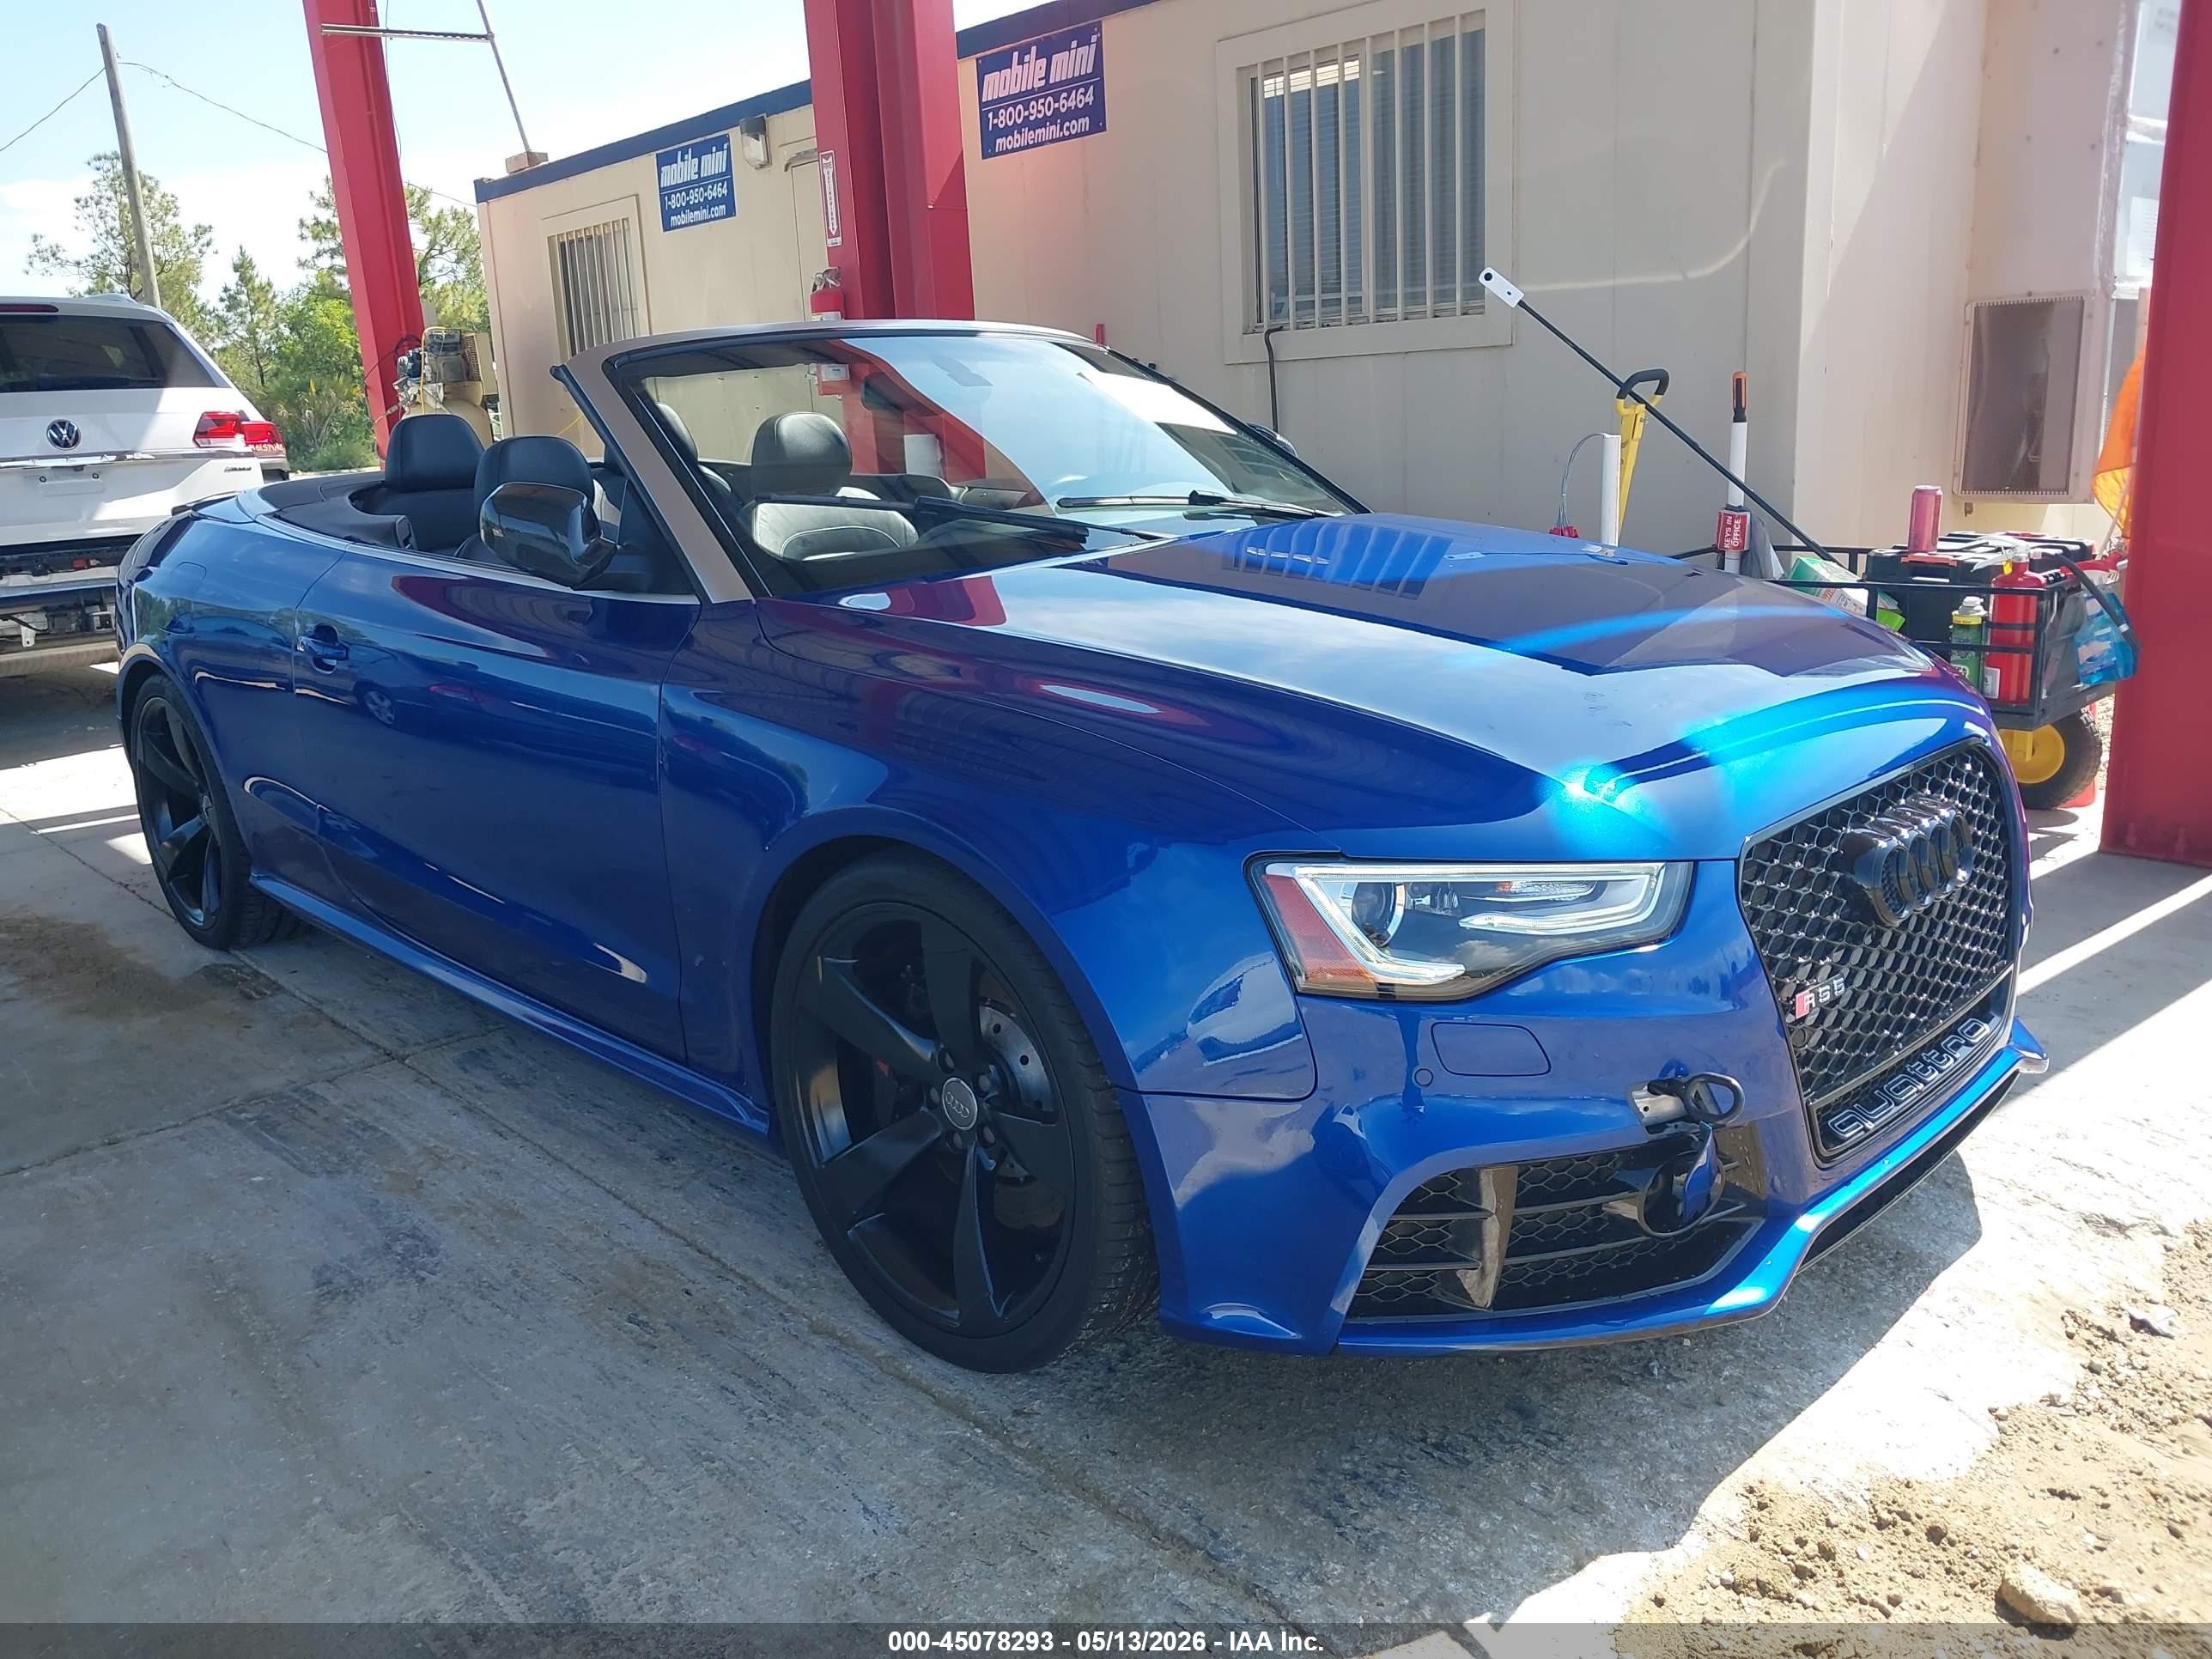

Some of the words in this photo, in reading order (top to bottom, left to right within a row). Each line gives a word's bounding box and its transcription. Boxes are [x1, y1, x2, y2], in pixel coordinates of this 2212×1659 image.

[981, 46, 1047, 102] mobile
[1049, 34, 1097, 84] mini
[988, 85, 1094, 131] 1-800-950-6464
[995, 116, 1090, 153] mobilemini.com
[660, 147, 699, 188] mobile
[700, 143, 728, 178] mini
[665, 180, 728, 210] 1-800-950-6464
[670, 204, 726, 228] mobilemini.com
[1726, 515, 1732, 524] IN
[1732, 516, 1741, 546] OFFICE
[1828, 1018, 1990, 1138] quattro
